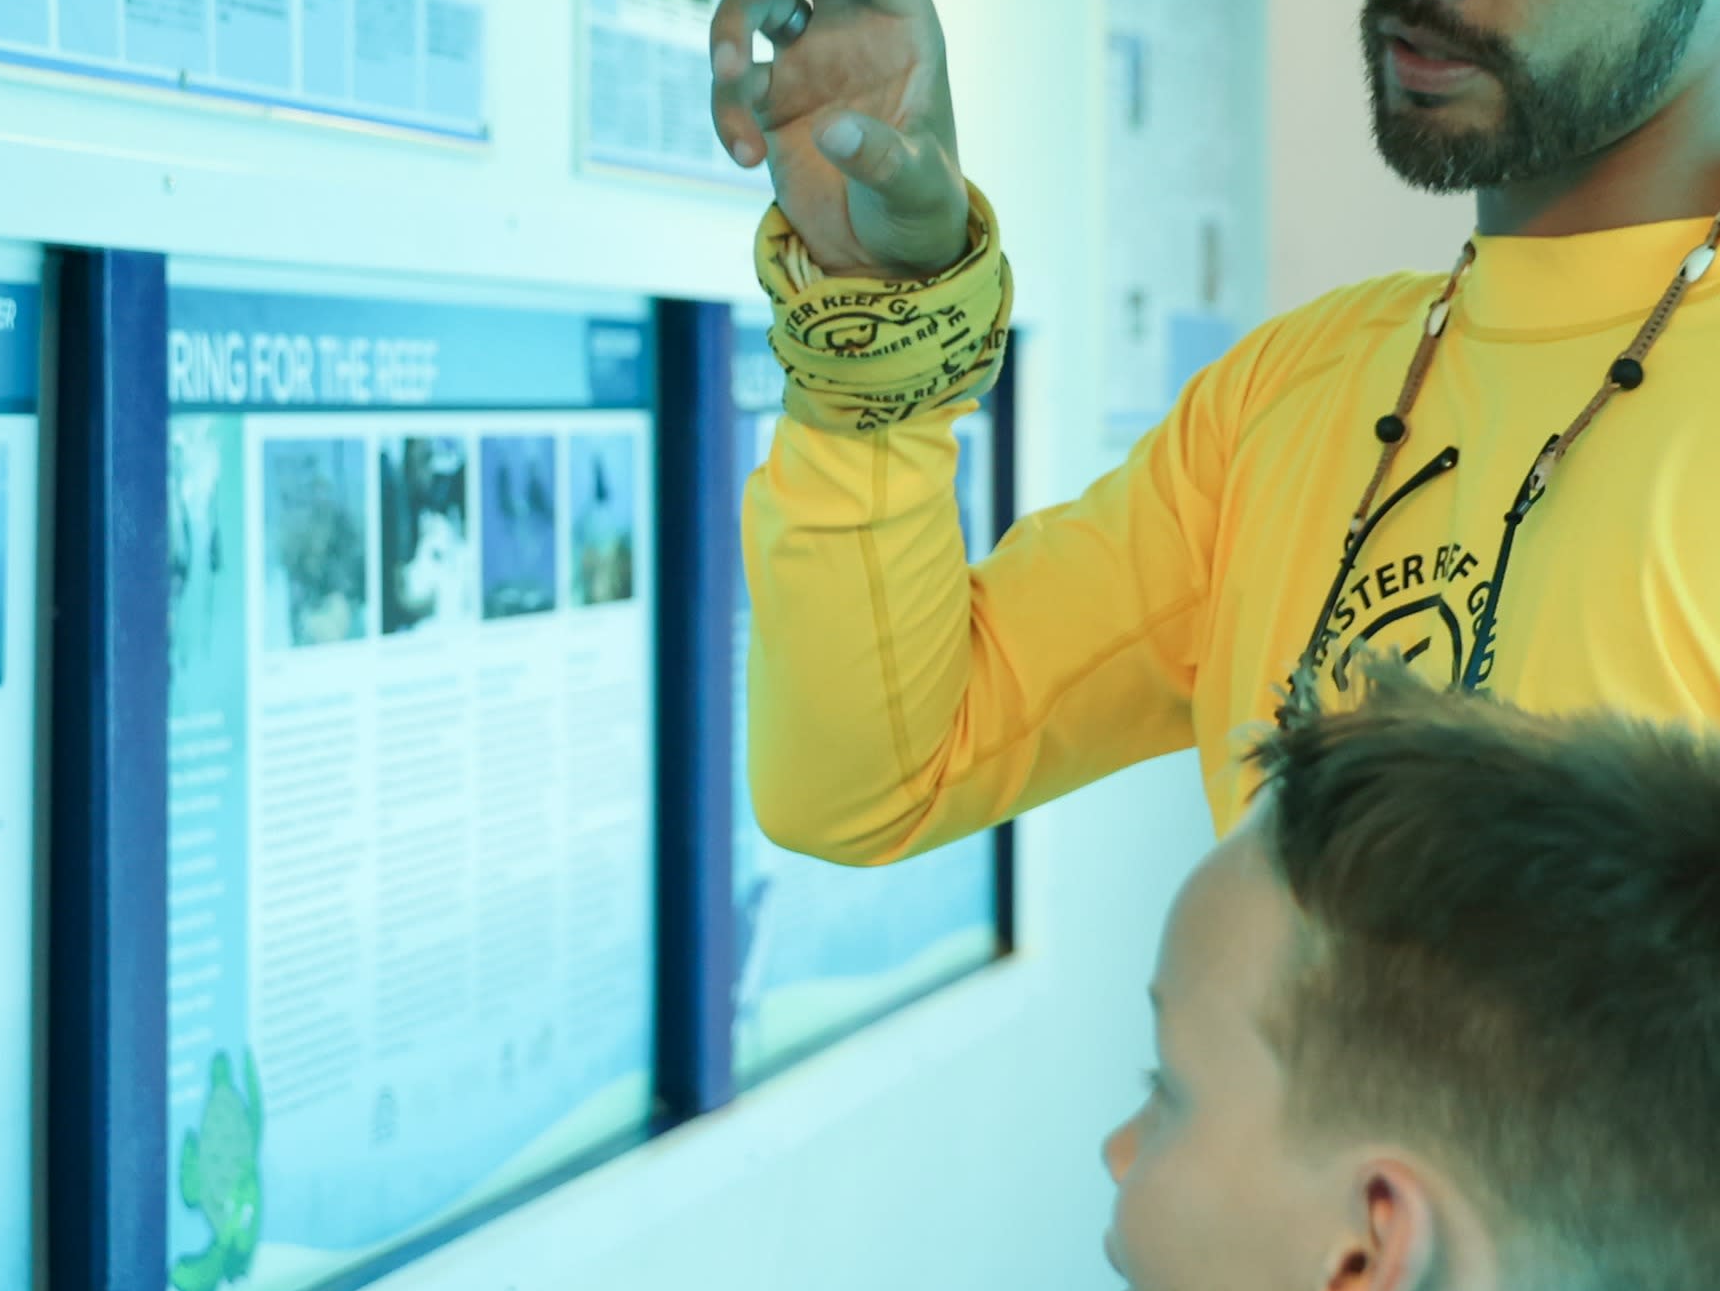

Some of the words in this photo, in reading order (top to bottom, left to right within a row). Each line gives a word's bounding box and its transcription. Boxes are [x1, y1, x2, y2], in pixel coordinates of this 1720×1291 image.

[168, 331, 247, 403] RING
[251, 333, 315, 403] FOR
[1314, 554, 1425, 668] ASTER
